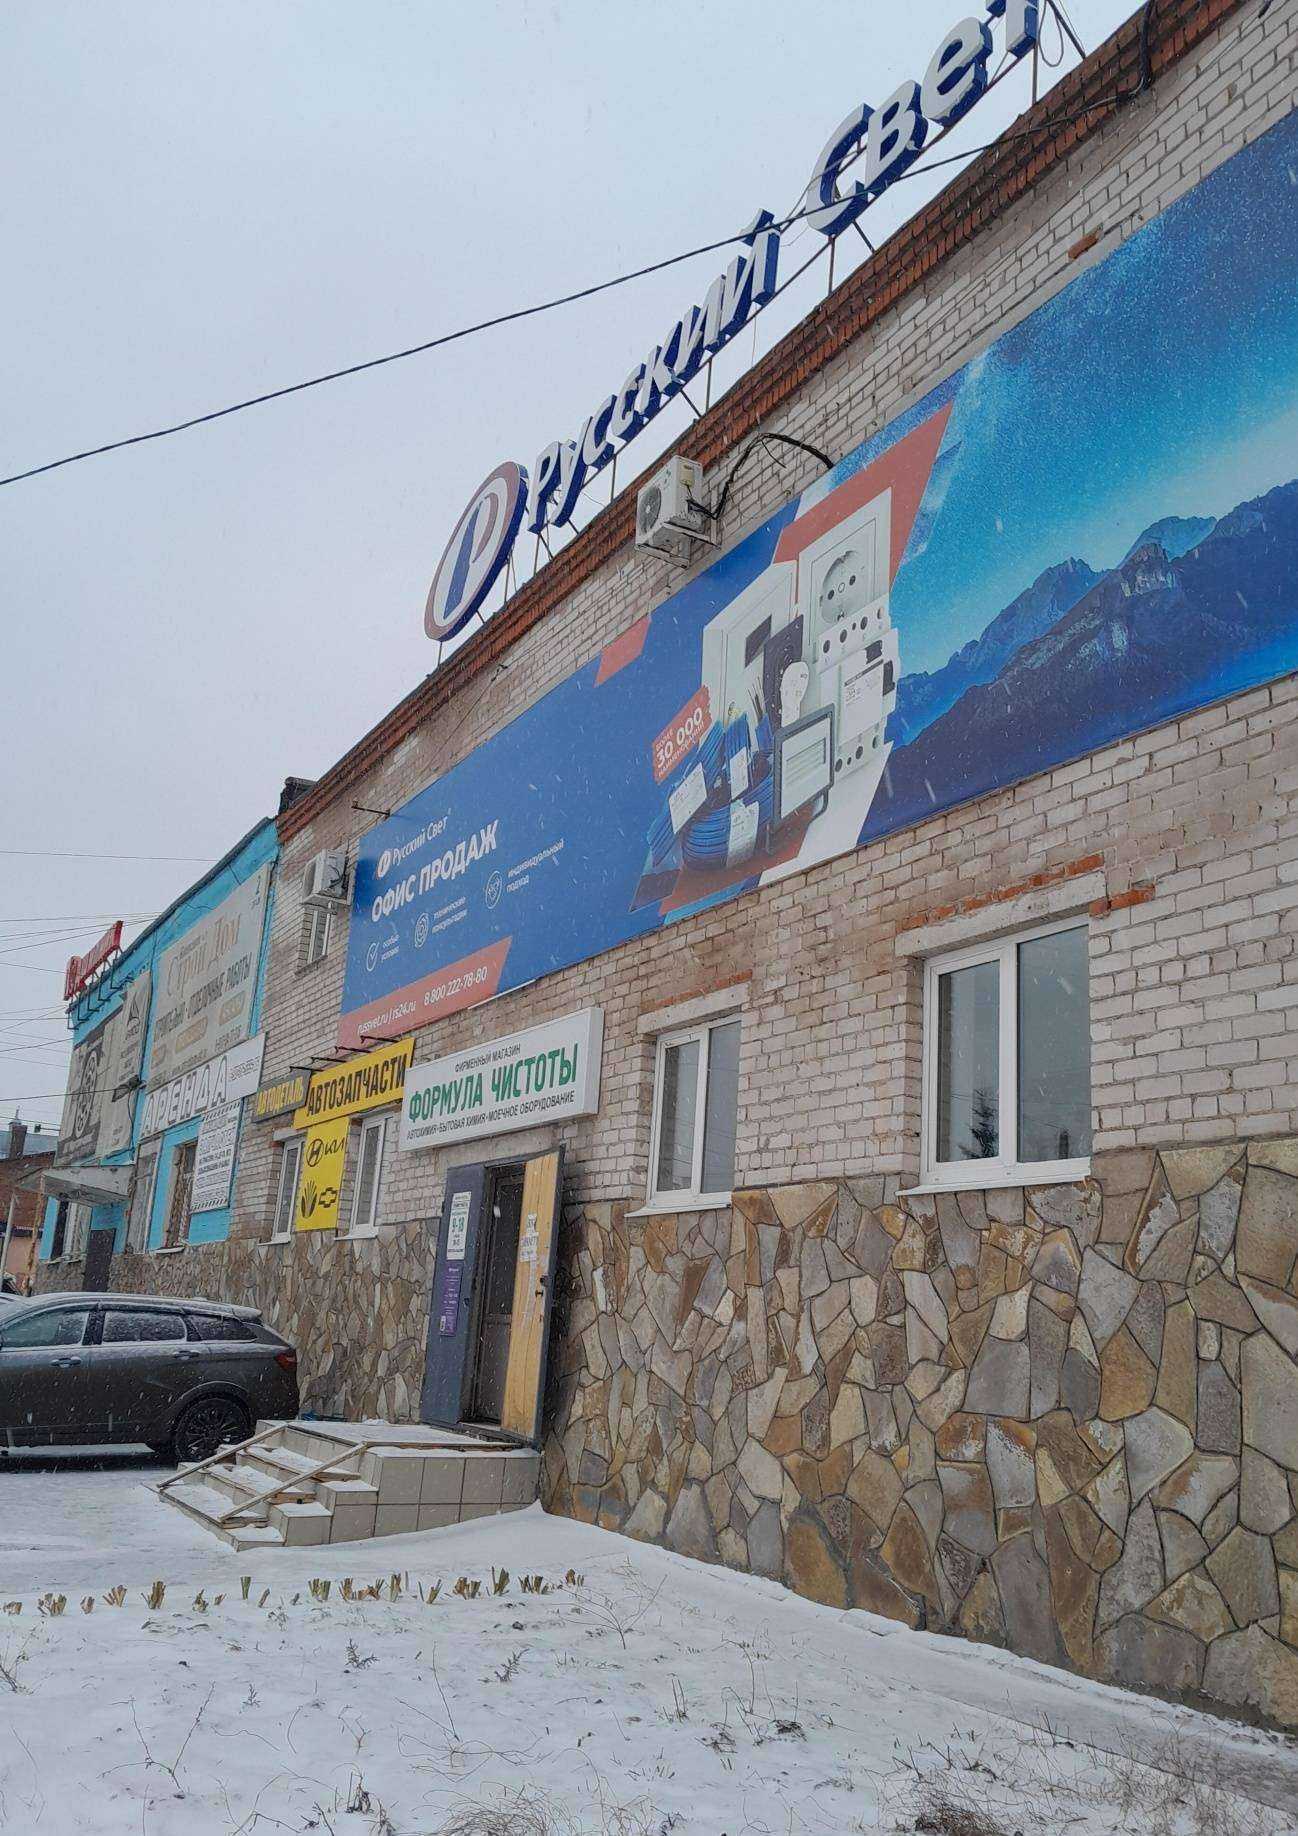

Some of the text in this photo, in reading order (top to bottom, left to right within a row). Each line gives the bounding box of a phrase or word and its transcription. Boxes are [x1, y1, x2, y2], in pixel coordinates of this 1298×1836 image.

[527, 208, 781, 533] Русский
[656, 741, 674, 768] 30
[676, 707, 703, 745] 000
[371, 818, 500, 922] ОФИС ПРОДАЖ
[392, 815, 449, 865] Русский Свет
[446, 966, 488, 997] 222-78-80
[306, 1053, 407, 1117] АВТОЗАПЧАСТИ
[408, 1042, 578, 1124] ФОРМУЛА ЧИСТОТЫ
[455, 1043, 521, 1073] ФИРМЕННЫЙ МАГАЗИН
[141, 1055, 227, 1138] АРЕНДА
[519, 1091, 575, 1116] ОБОРУДОВАНИЕ
